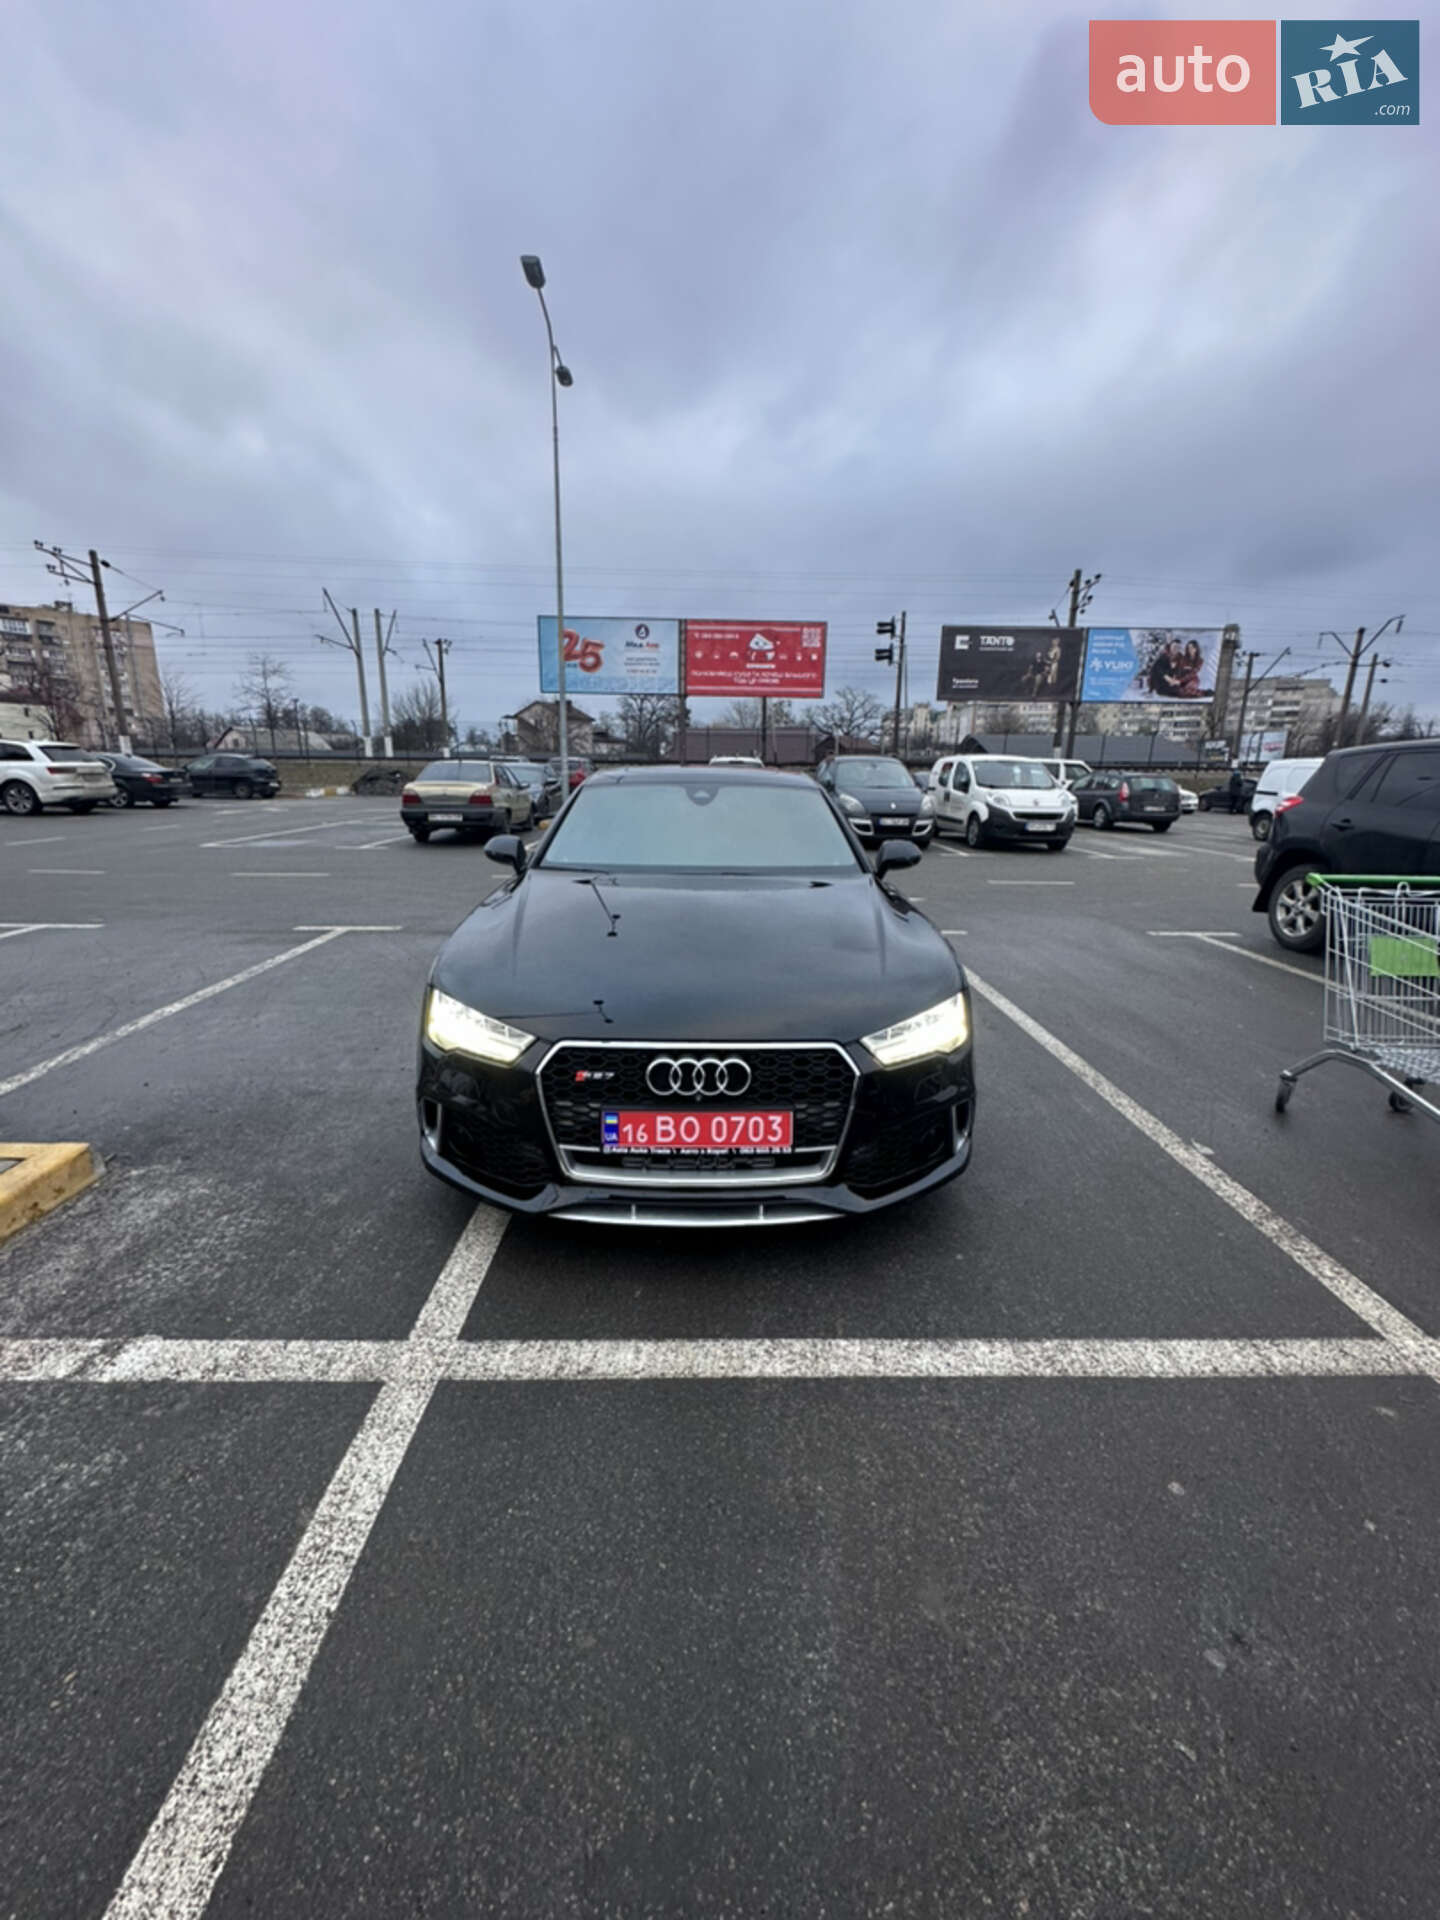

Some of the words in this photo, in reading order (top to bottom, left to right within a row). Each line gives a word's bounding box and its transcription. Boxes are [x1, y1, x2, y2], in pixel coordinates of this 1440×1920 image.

[604, 1131, 618, 1142] UA
[622, 1123, 649, 1144] 16
[655, 1115, 700, 1144] BO
[711, 1115, 783, 1143] 0703
